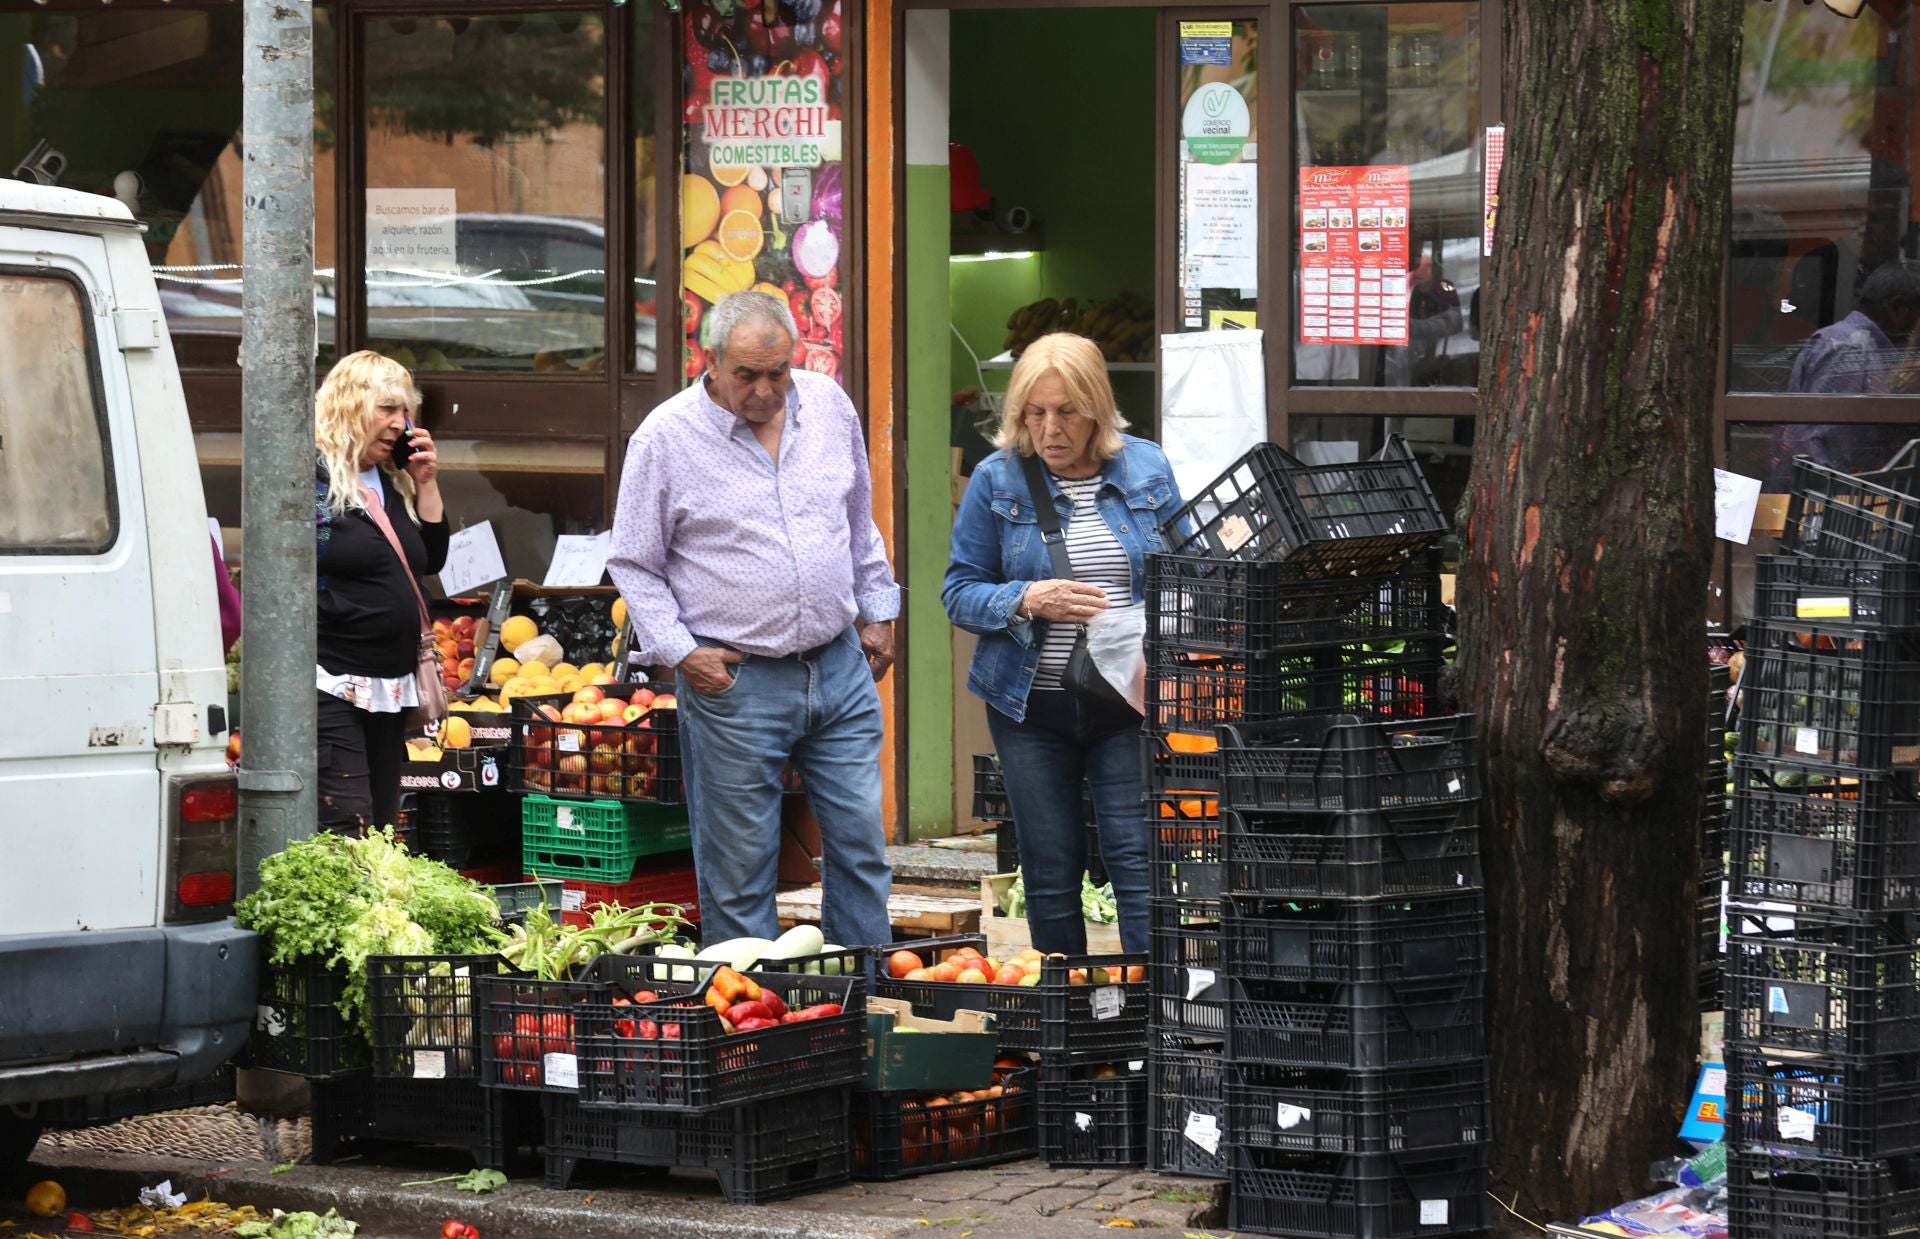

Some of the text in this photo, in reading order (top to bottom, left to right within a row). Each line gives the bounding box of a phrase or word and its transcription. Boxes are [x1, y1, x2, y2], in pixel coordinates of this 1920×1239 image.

[714, 80, 818, 105] FRUTAS
[706, 106, 825, 138] MERCHI
[1202, 126, 1231, 134] vecinal
[712, 144, 818, 165] COMESTIBLES
[375, 204, 450, 215] Buscamos bar de
[419, 224, 443, 235] razón
[394, 245, 405, 255] en
[407, 243, 415, 255] la
[1698, 1102, 1720, 1119] EL
